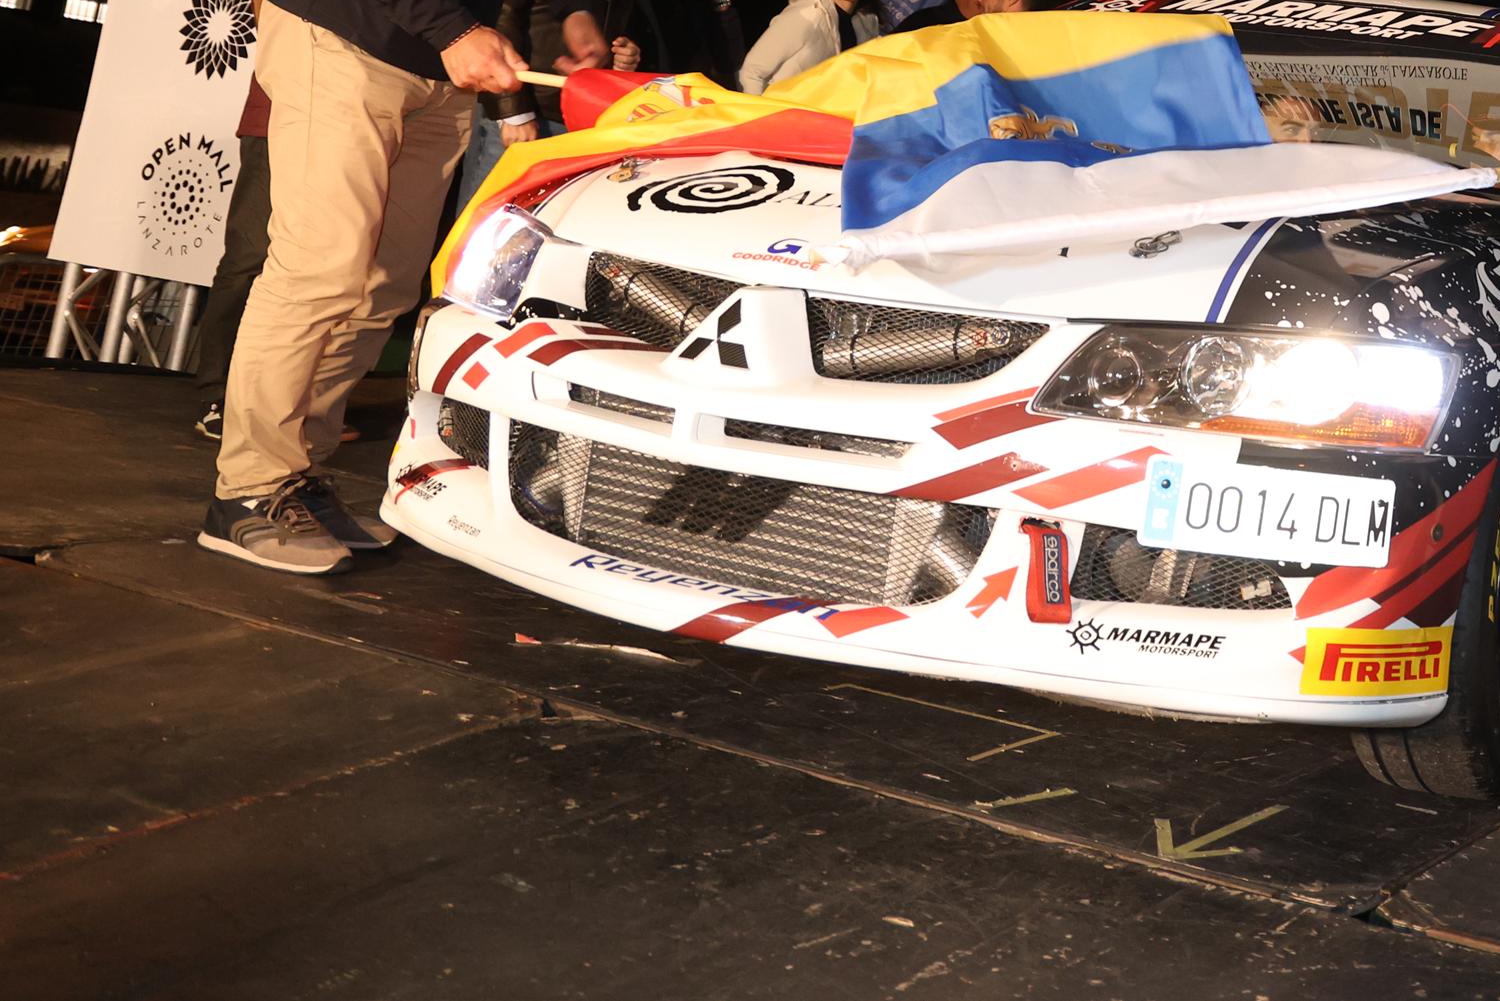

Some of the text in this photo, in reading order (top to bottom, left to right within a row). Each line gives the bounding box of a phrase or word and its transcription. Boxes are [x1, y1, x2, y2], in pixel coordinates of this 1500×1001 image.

[141, 132, 191, 181] OPEN
[197, 134, 233, 193] MALL
[137, 201, 223, 256] LANZAROTE
[732, 251, 822, 271] GOODRIDGE
[1185, 482, 1298, 541] 0014
[1043, 535, 1062, 603] sparco
[1107, 626, 1227, 650] MARMAPE
[1138, 643, 1218, 659] MOTORSPORT
[1319, 640, 1443, 682] PIRELLI
